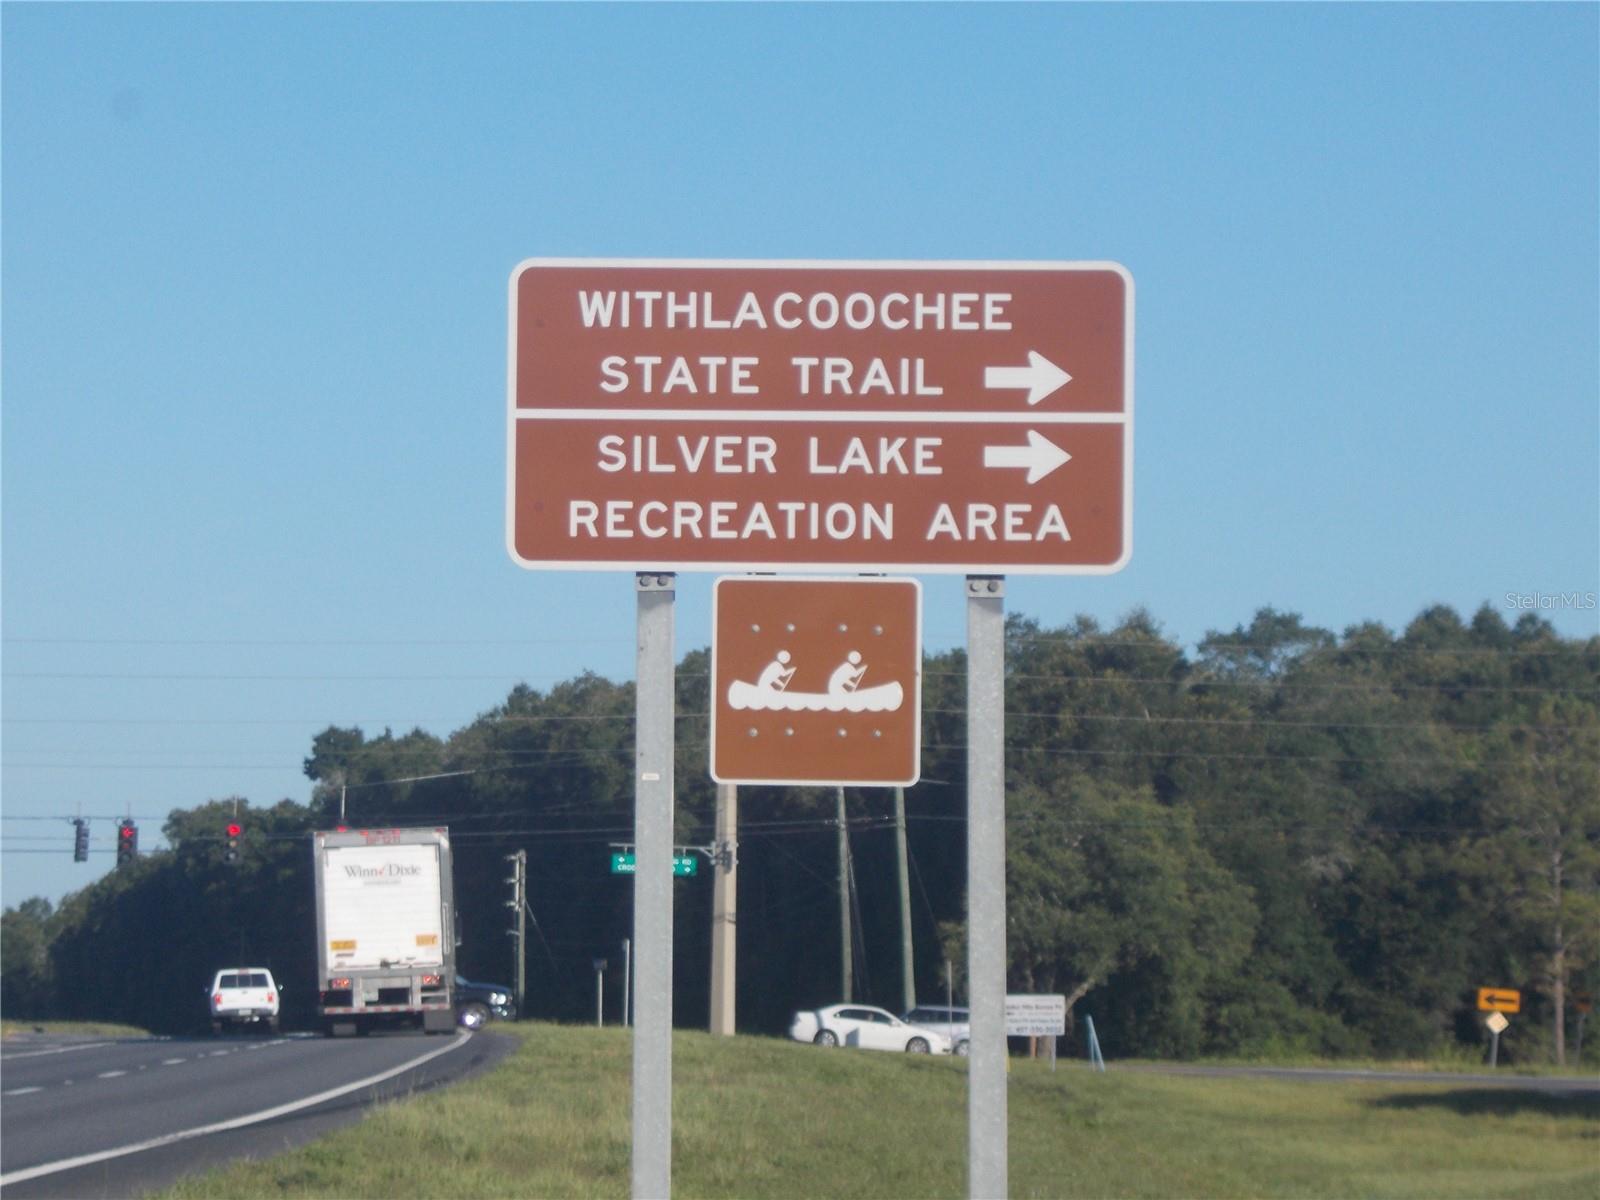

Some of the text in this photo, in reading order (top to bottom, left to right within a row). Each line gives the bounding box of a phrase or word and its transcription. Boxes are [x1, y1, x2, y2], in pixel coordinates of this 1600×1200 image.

[578, 290, 1013, 331] WITHLACOOCHEE
[599, 355, 944, 396] STATE TRAIL
[597, 434, 943, 475] SILVER LAKE
[568, 500, 1072, 542] RECREATION AREA
[387, 862, 422, 877] Dixie
